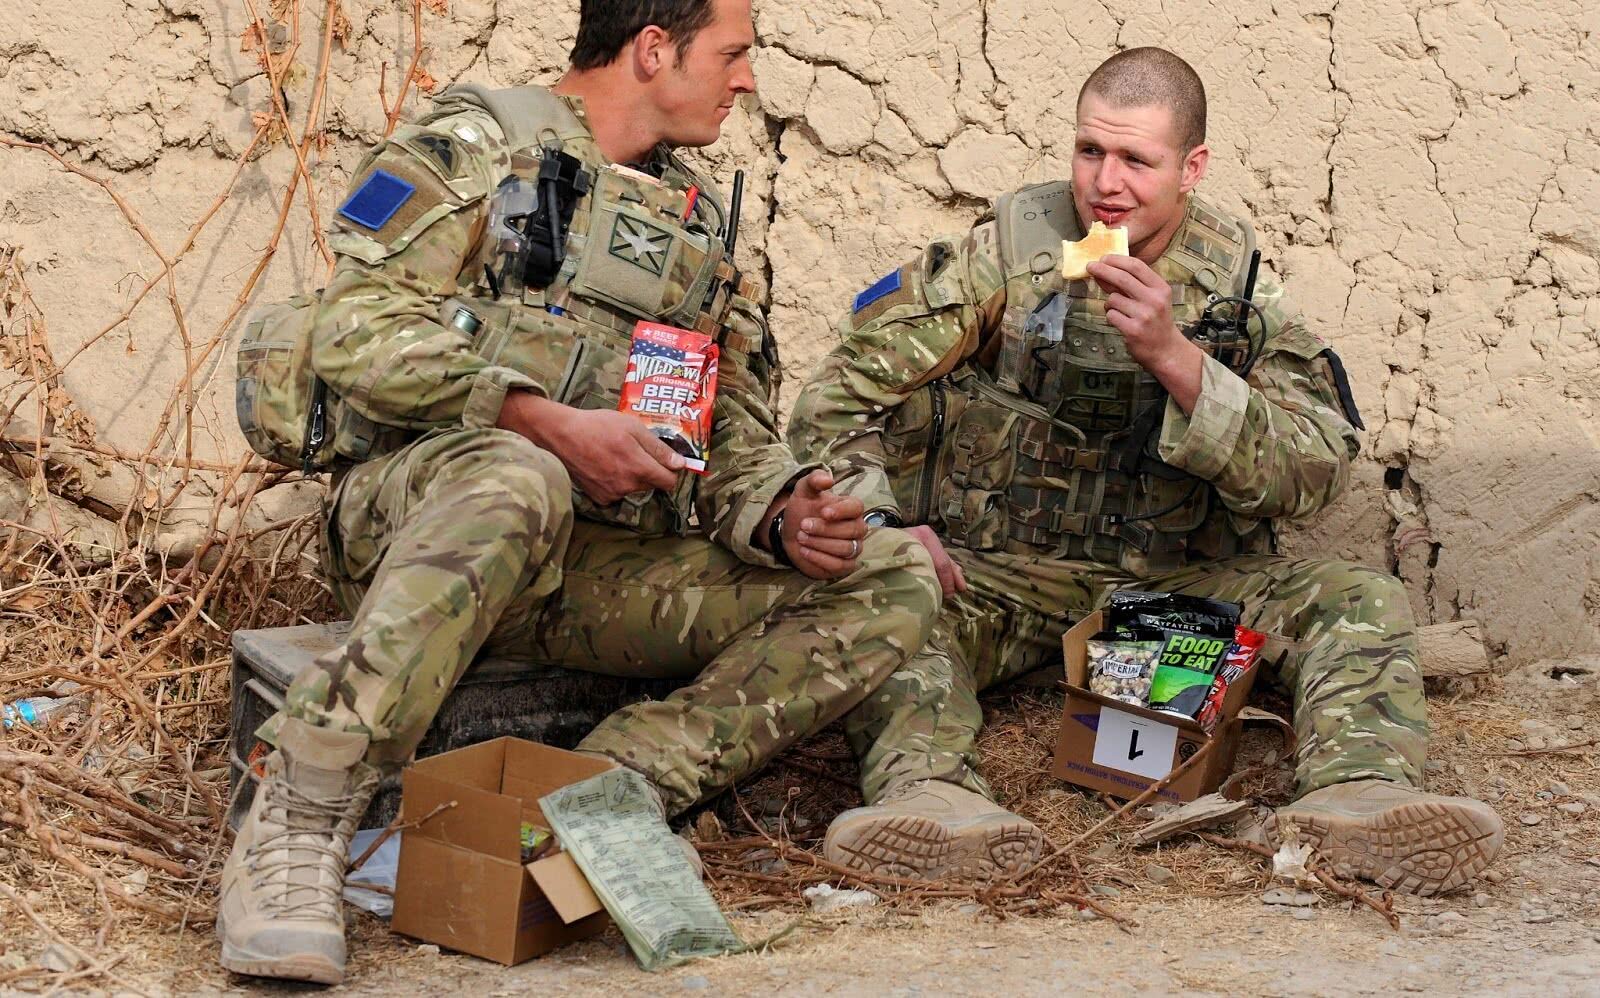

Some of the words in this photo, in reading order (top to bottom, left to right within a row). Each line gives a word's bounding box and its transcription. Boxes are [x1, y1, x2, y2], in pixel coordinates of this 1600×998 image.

[653, 331, 679, 340] BEEF
[635, 353, 674, 384] WILD
[652, 376, 697, 389] ORIGINAL
[642, 384, 700, 404] BEEF
[632, 398, 702, 421] JERKY
[1166, 634, 1225, 655] FOOD
[1105, 662, 1141, 675] IMPERIAL
[1159, 652, 1182, 665] TO
[1184, 655, 1217, 671] EAT
[1128, 729, 1144, 761] 1
